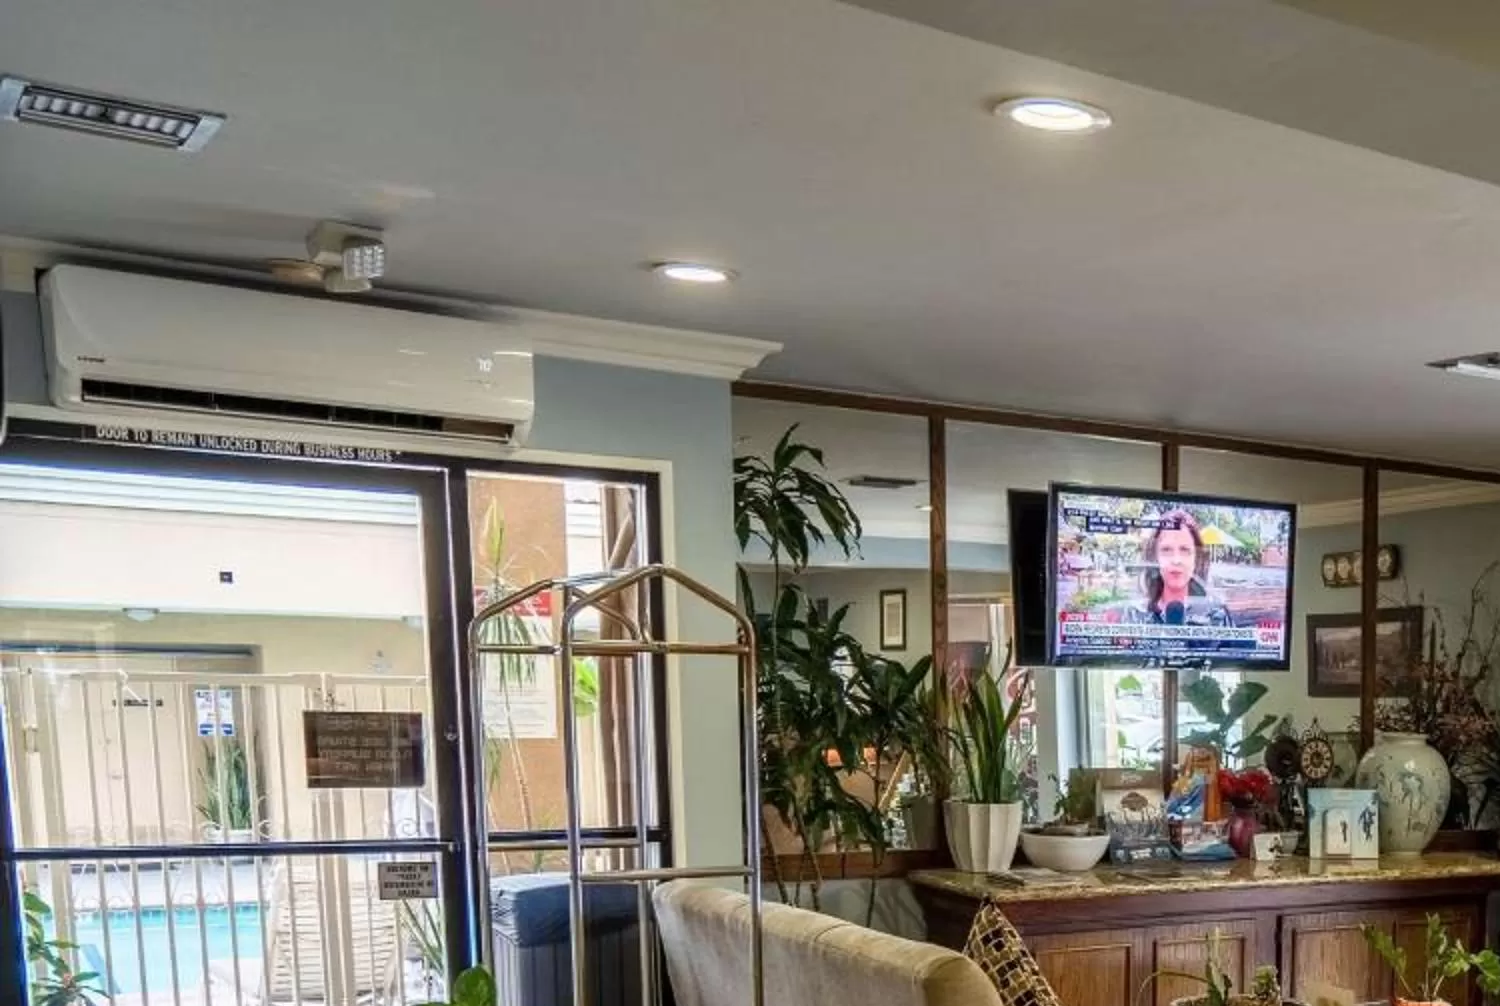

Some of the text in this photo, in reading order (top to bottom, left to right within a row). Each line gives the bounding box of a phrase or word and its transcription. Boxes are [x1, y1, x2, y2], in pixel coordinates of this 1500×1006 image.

[97, 424, 129, 440] DOOR
[132, 427, 149, 442] TO
[151, 430, 197, 447] REMAIN
[199, 434, 257, 452] UNLOCKED
[261, 439, 300, 456] DURING
[303, 443, 355, 459] BUSINESS
[1260, 630, 1280, 643] CNN
